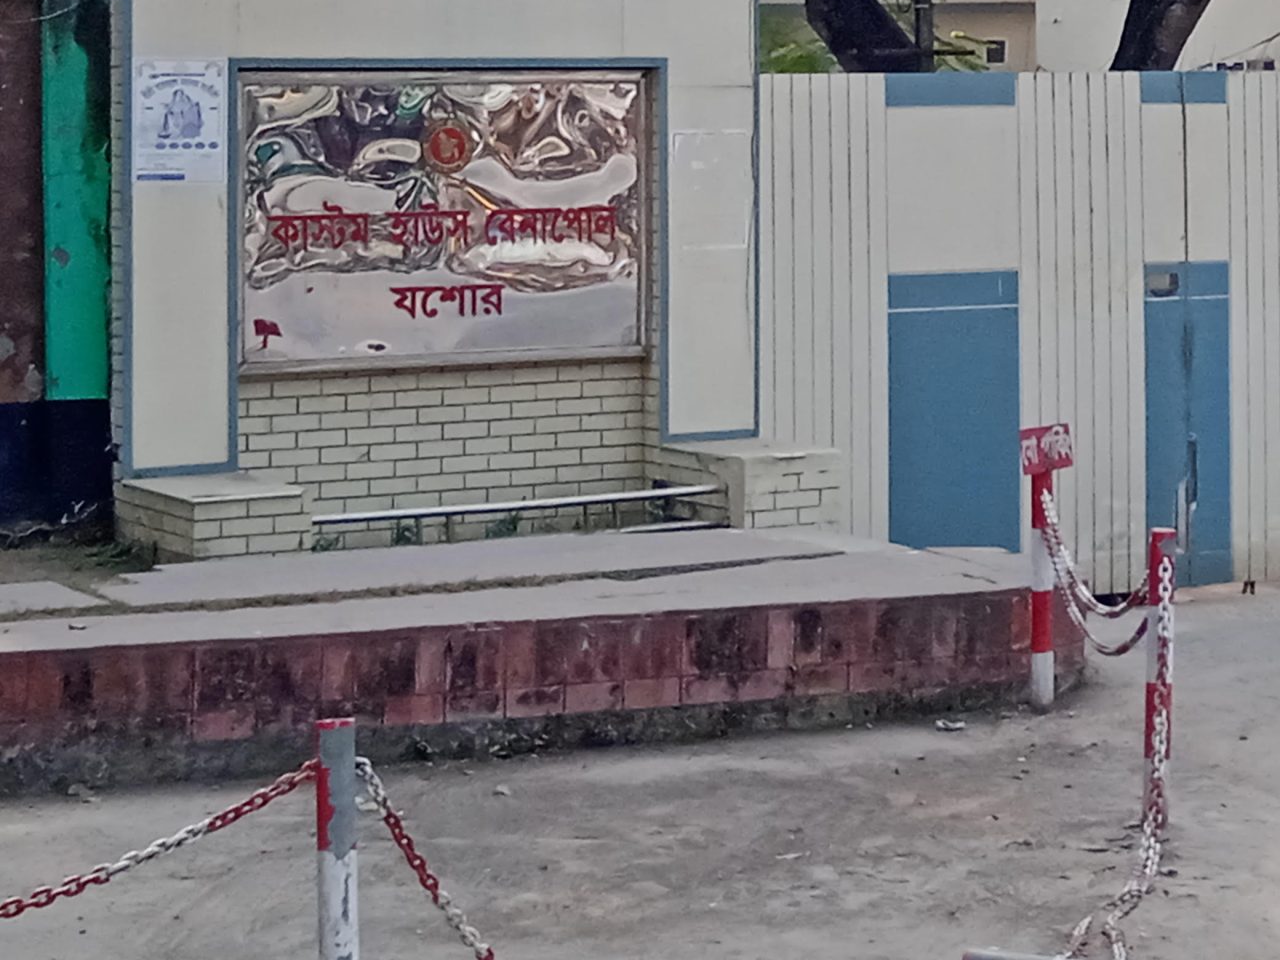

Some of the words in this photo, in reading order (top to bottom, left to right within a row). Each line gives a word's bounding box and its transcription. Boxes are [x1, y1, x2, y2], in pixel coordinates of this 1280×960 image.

[267, 201, 369, 250] কাস্টম
[385, 203, 471, 247] হাউস
[484, 204, 620, 247] বেনাপোল
[389, 283, 506, 320] যশোর
